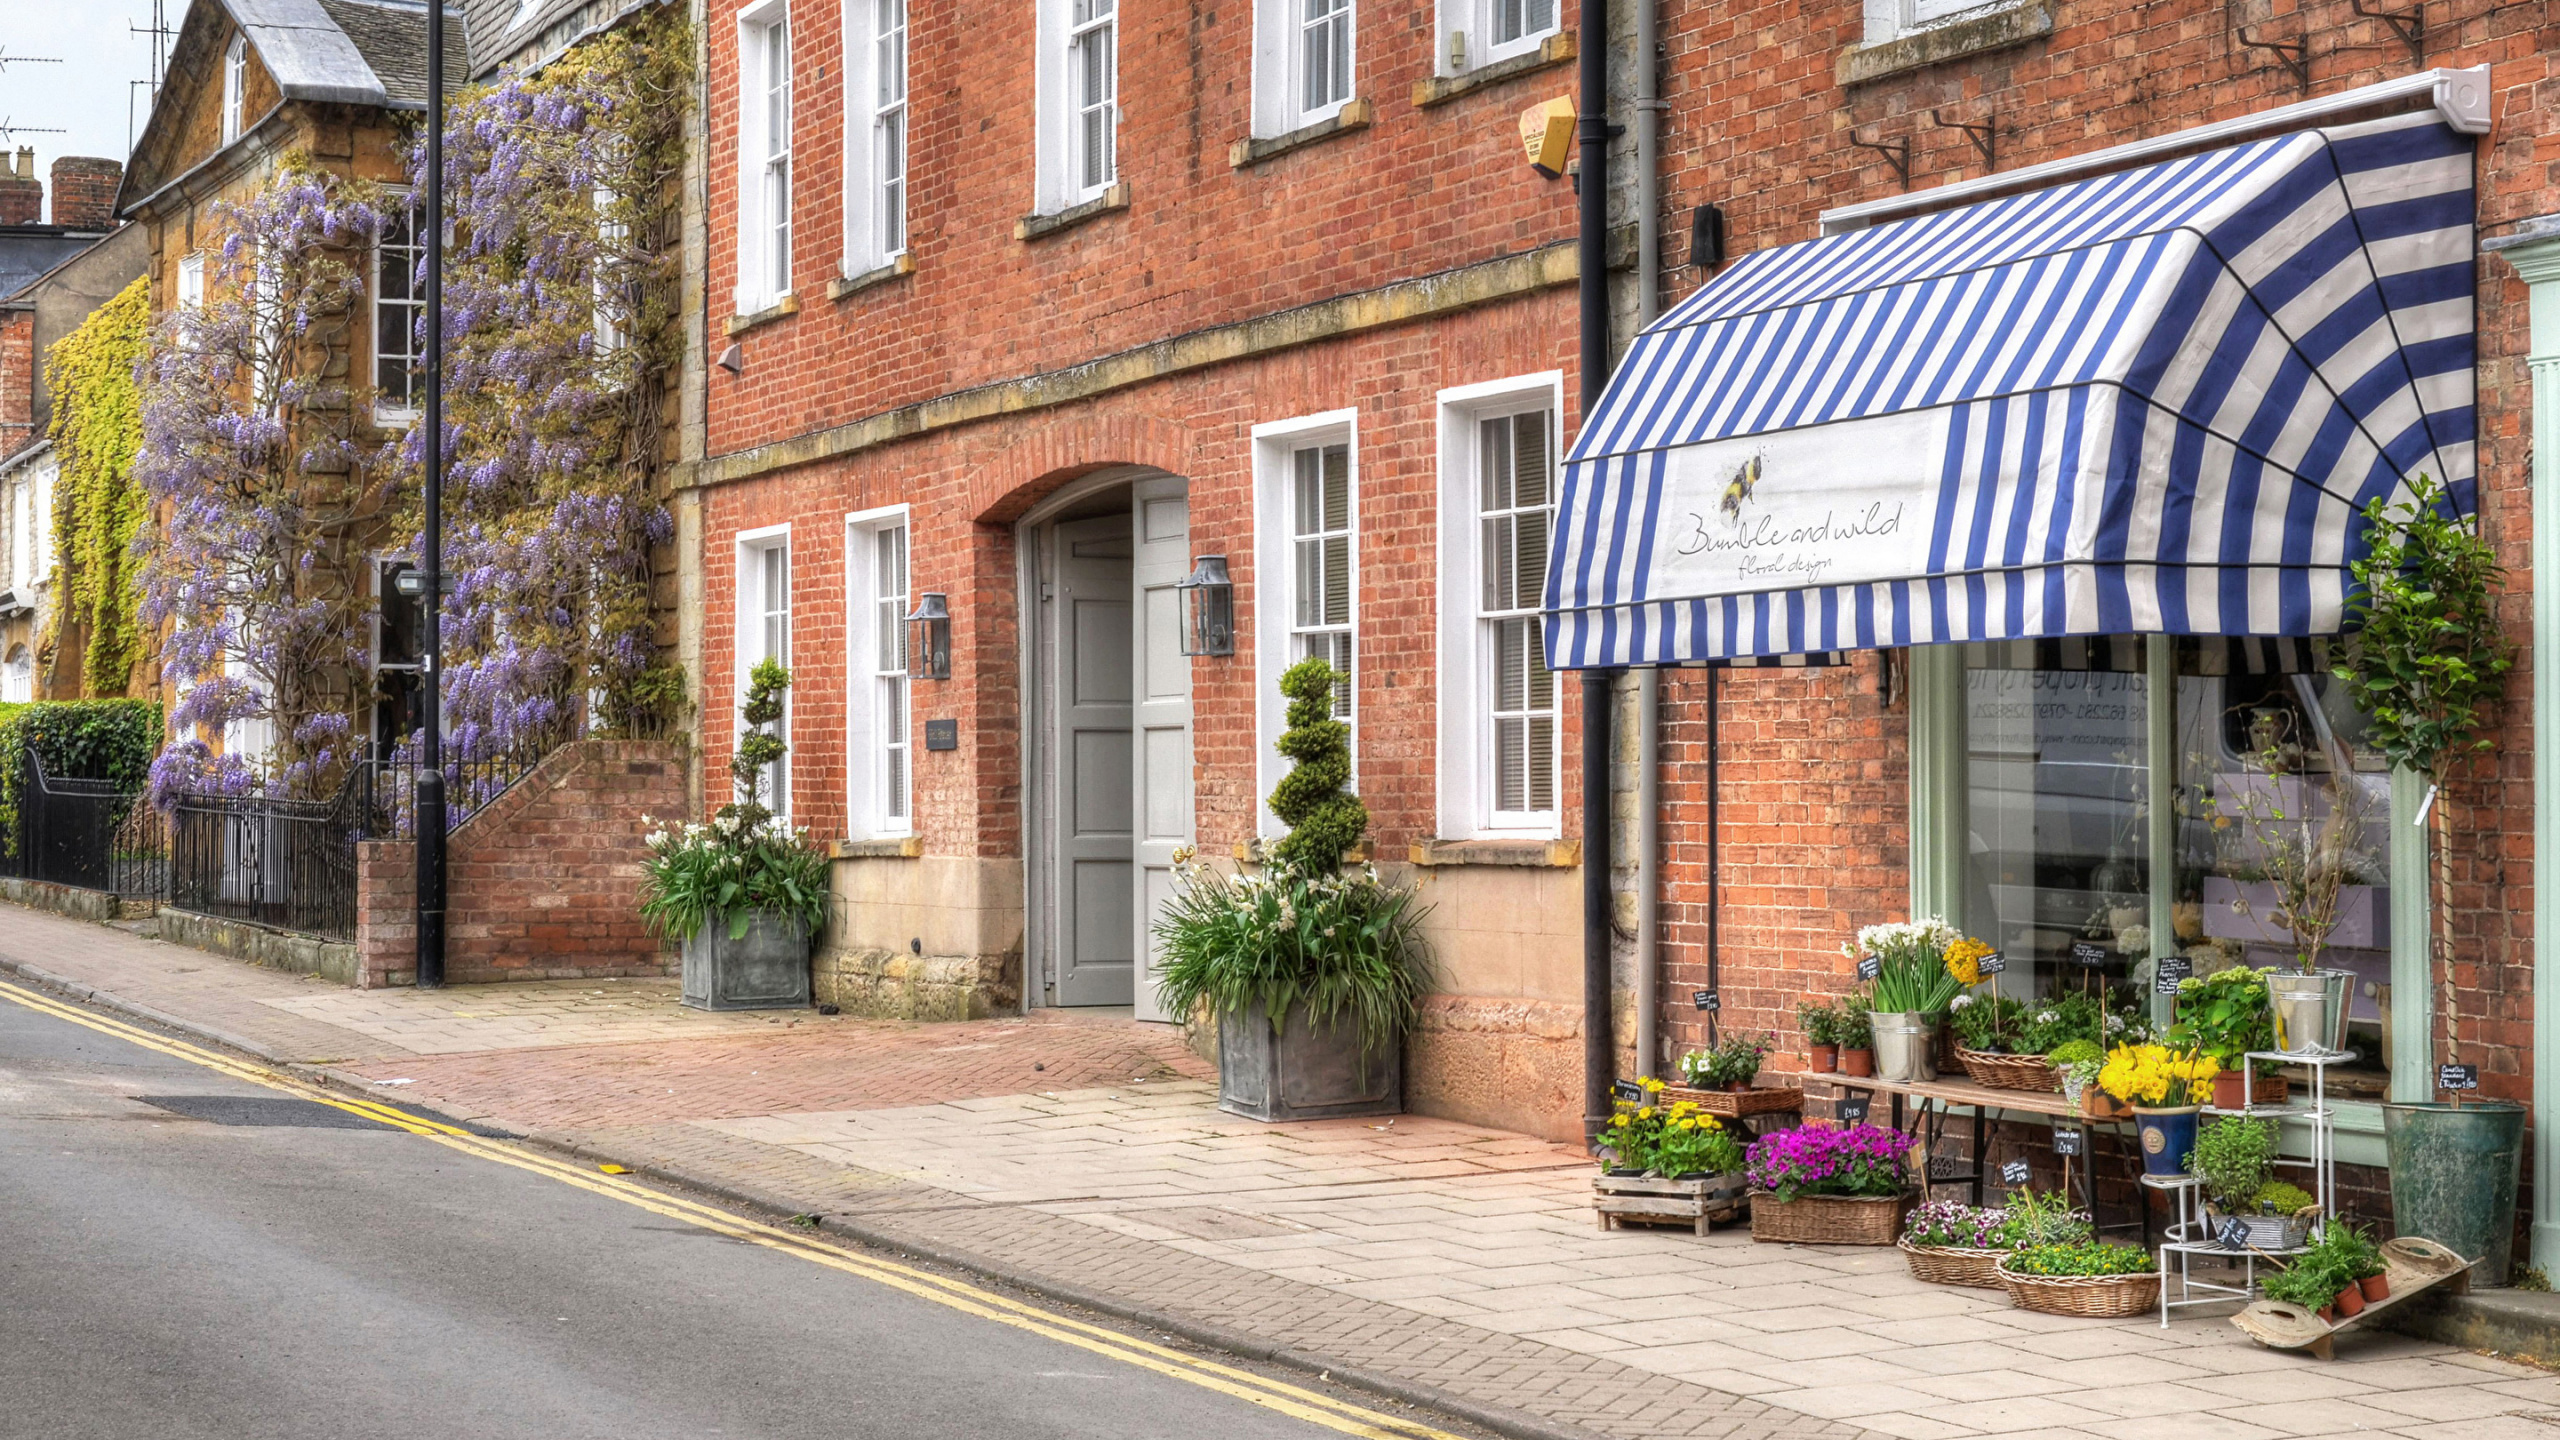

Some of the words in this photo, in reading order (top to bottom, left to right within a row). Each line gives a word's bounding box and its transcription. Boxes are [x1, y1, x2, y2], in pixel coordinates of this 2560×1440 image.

[1677, 512, 1788, 555] Bumble
[1790, 510, 1833, 543] and
[1834, 501, 1905, 540] wild
[1738, 553, 1787, 580] floral
[1788, 553, 1832, 583] design
